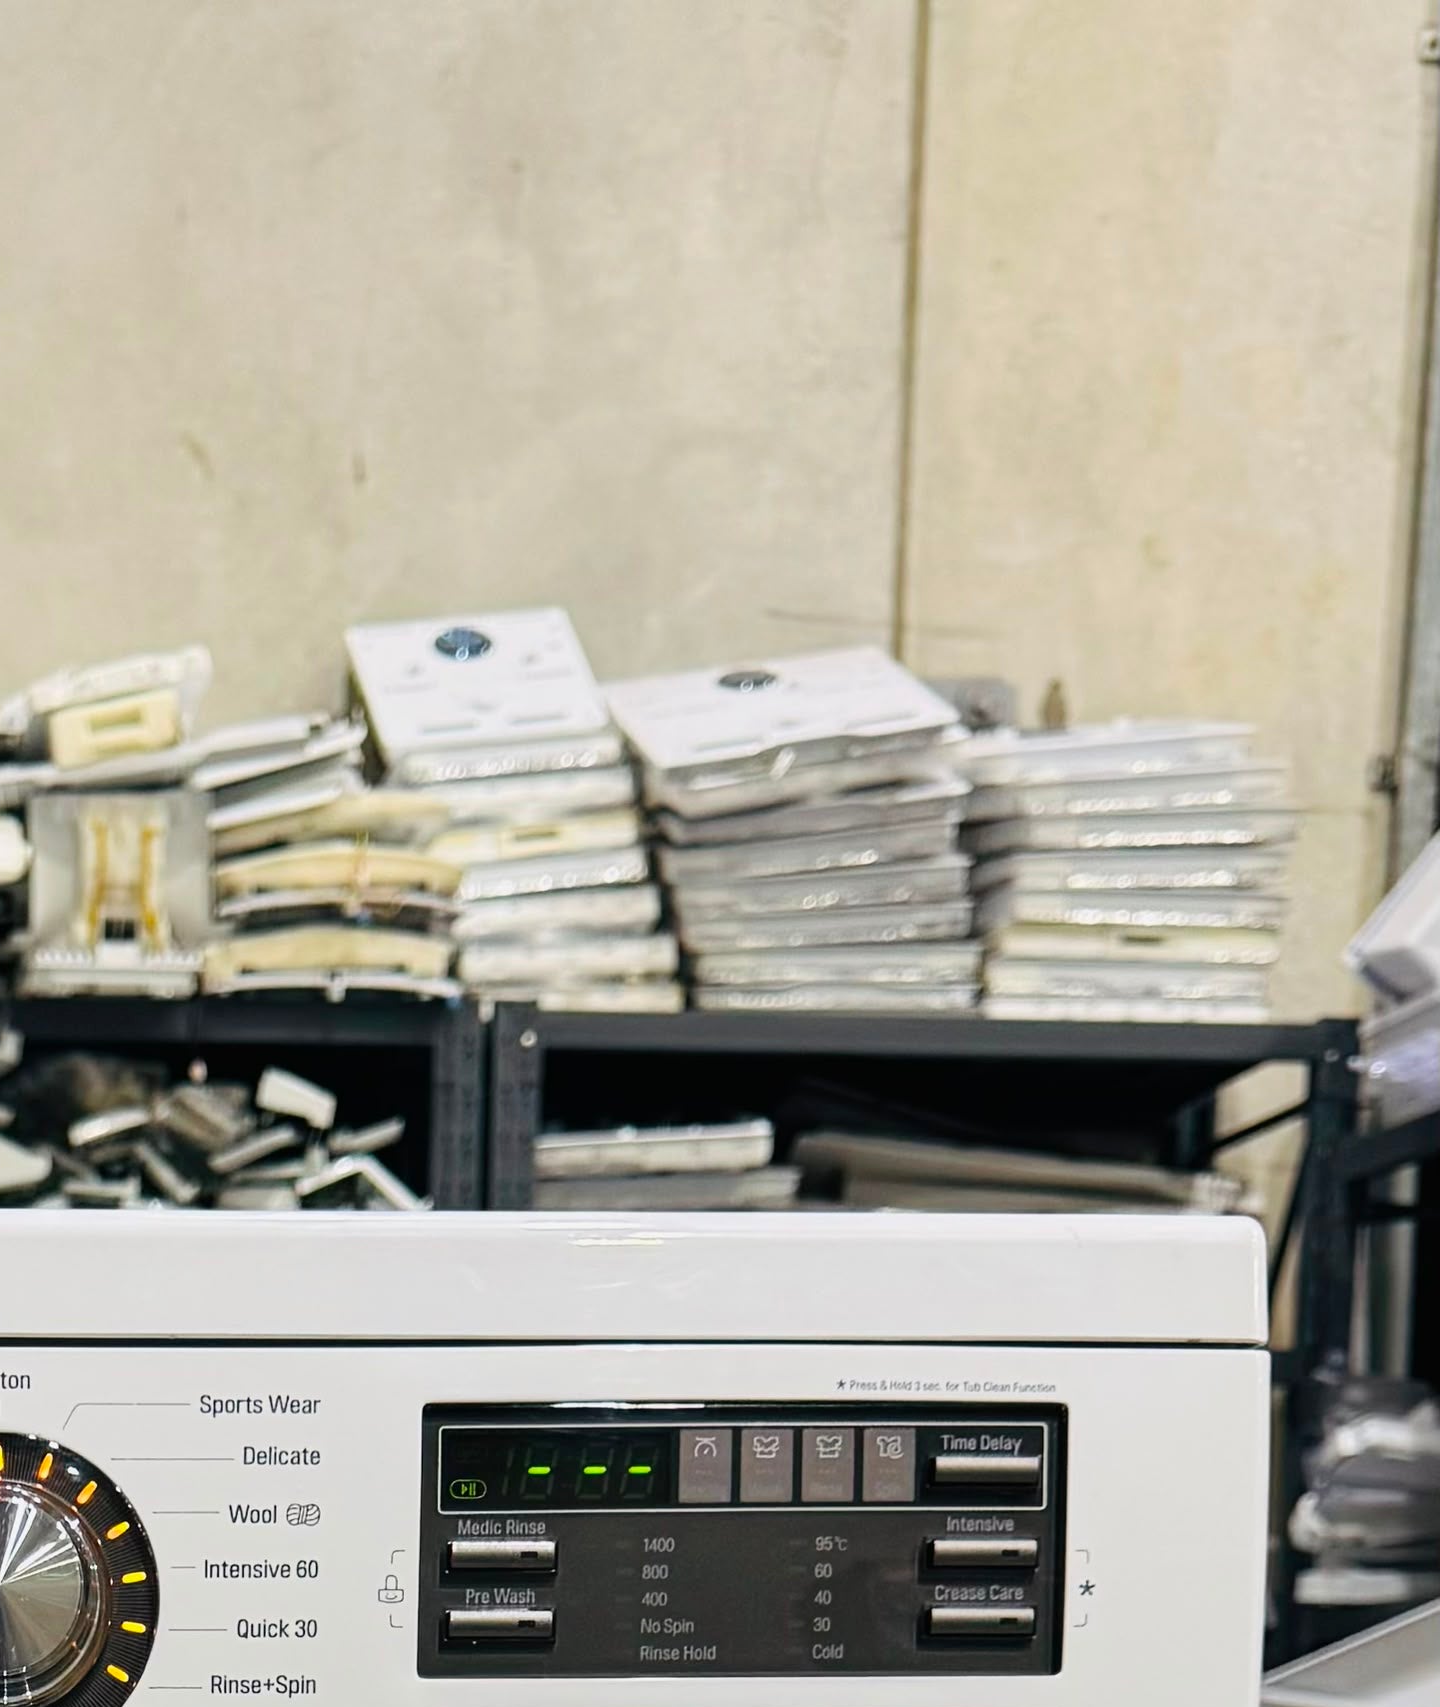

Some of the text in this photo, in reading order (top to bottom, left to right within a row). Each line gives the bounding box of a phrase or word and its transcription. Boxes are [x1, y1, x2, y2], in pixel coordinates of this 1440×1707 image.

[849, 1380, 877, 1391] Press
[880, 1381, 887, 1391] &
[890, 1381, 911, 1391] Hold
[946, 1382, 959, 1392] for
[963, 1382, 980, 1392] Tub
[983, 1382, 1011, 1392] Clean
[1013, 1383, 1056, 1392] Function
[199, 1394, 321, 1418] Sports Wear
[941, 1435, 1022, 1456] Time Delay
[242, 1445, 321, 1466] Delicate
[228, 1502, 278, 1525] Wool
[458, 1519, 546, 1535] Medic Rinse
[946, 1516, 1014, 1532] Intensive
[643, 1538, 675, 1552] 1400
[202, 1558, 320, 1580] Intensive 60
[642, 1565, 669, 1580] 800
[814, 1563, 832, 1578] 60
[466, 1588, 535, 1604] Pre Wash
[642, 1592, 667, 1606] 400
[814, 1590, 831, 1604] 40
[934, 1585, 1024, 1600] Crease Care
[236, 1618, 319, 1641] Quick 30
[640, 1618, 695, 1637] No Spin
[813, 1617, 831, 1631] 30
[640, 1645, 716, 1660] Rinse Hold
[813, 1644, 844, 1659] Cold
[210, 1675, 318, 1699] Rinse+Spin
